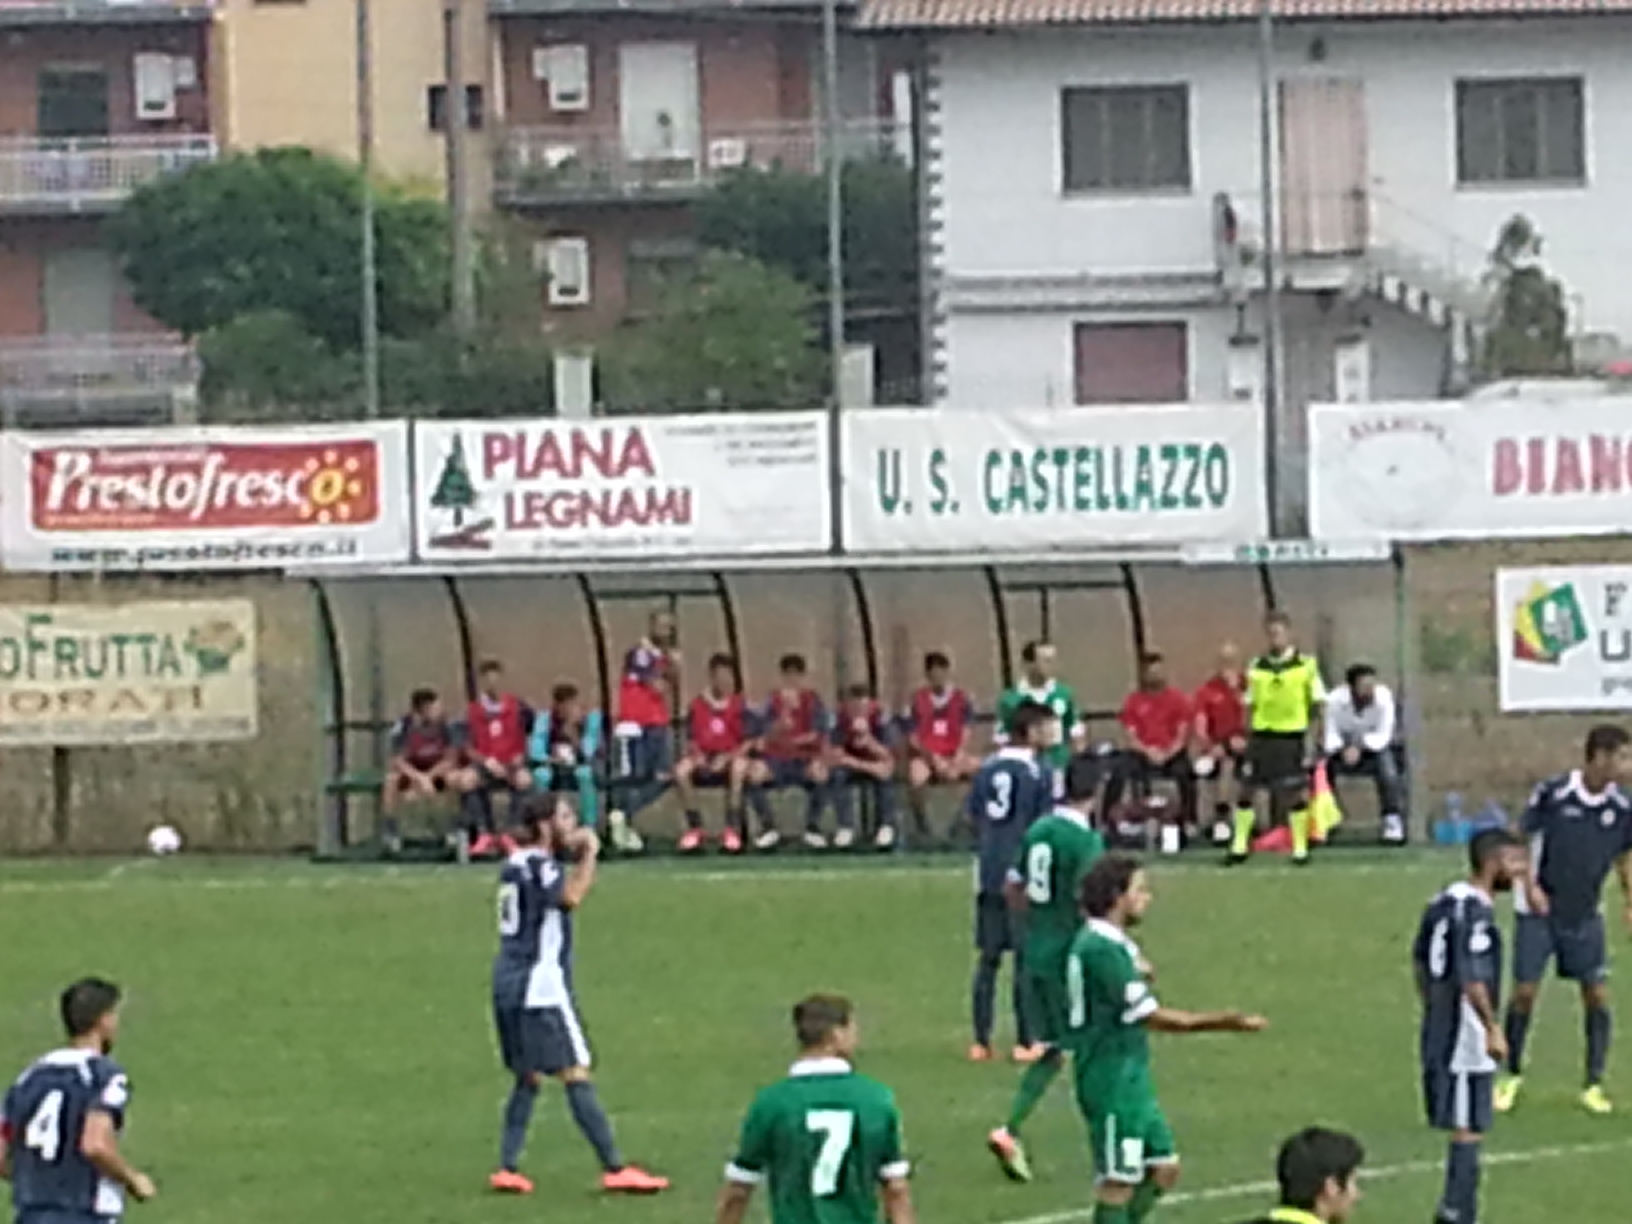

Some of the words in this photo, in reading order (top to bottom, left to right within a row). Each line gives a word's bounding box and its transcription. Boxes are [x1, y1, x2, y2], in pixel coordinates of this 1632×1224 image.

[44, 450, 345, 521] Prestofresco
[482, 426, 656, 481] PIANA
[876, 448, 913, 515] U.
[928, 448, 961, 515] S.
[983, 443, 1230, 515] CASTELLAZZO
[504, 487, 692, 531] LEGNAMI
[985, 771, 1013, 819] 3
[24, 1088, 64, 1161] 4
[805, 1108, 854, 1197] 7
